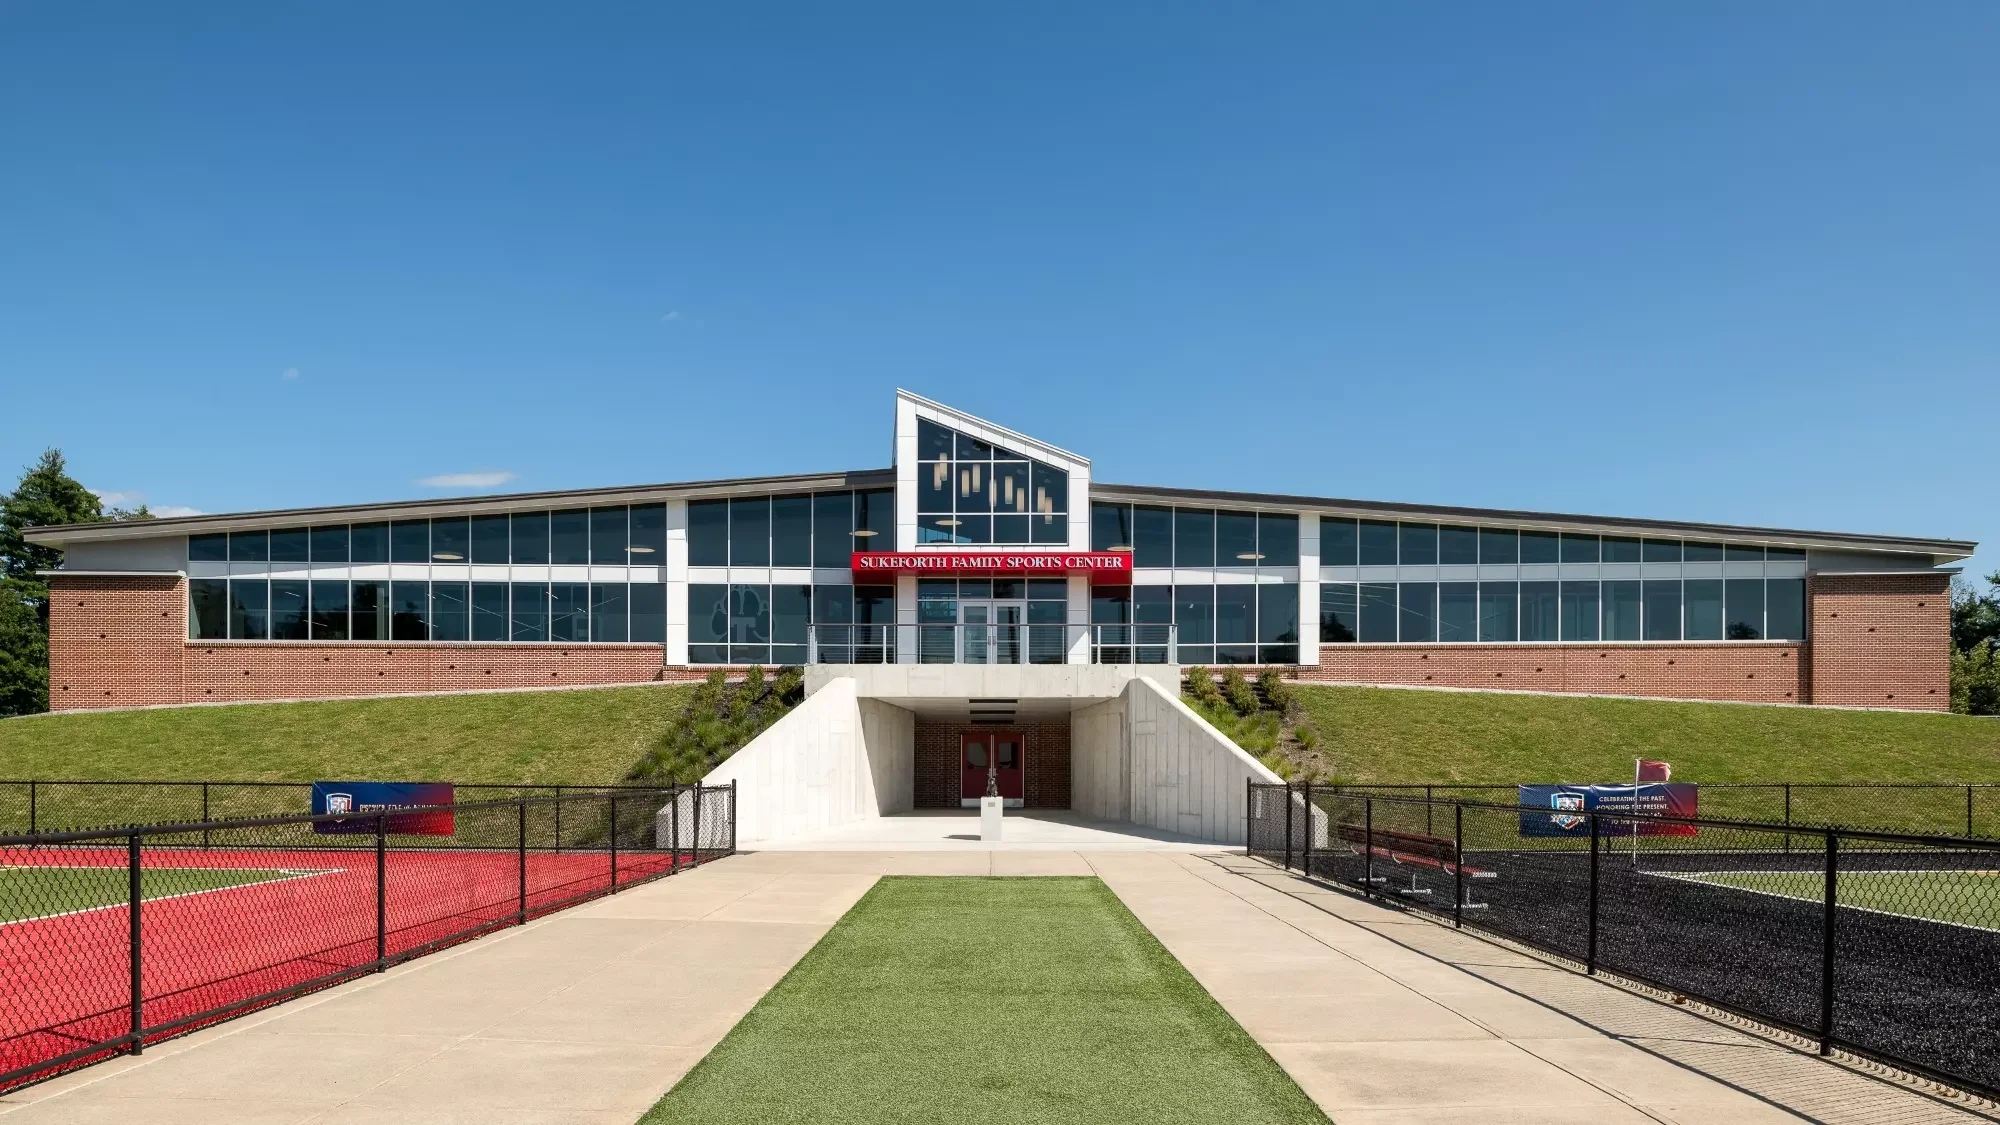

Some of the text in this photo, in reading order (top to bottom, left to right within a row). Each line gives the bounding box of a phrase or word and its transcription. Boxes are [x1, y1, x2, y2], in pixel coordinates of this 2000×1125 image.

[860, 556, 1123, 568] SUKEFORTH FAMILY SPORTS CENTER
